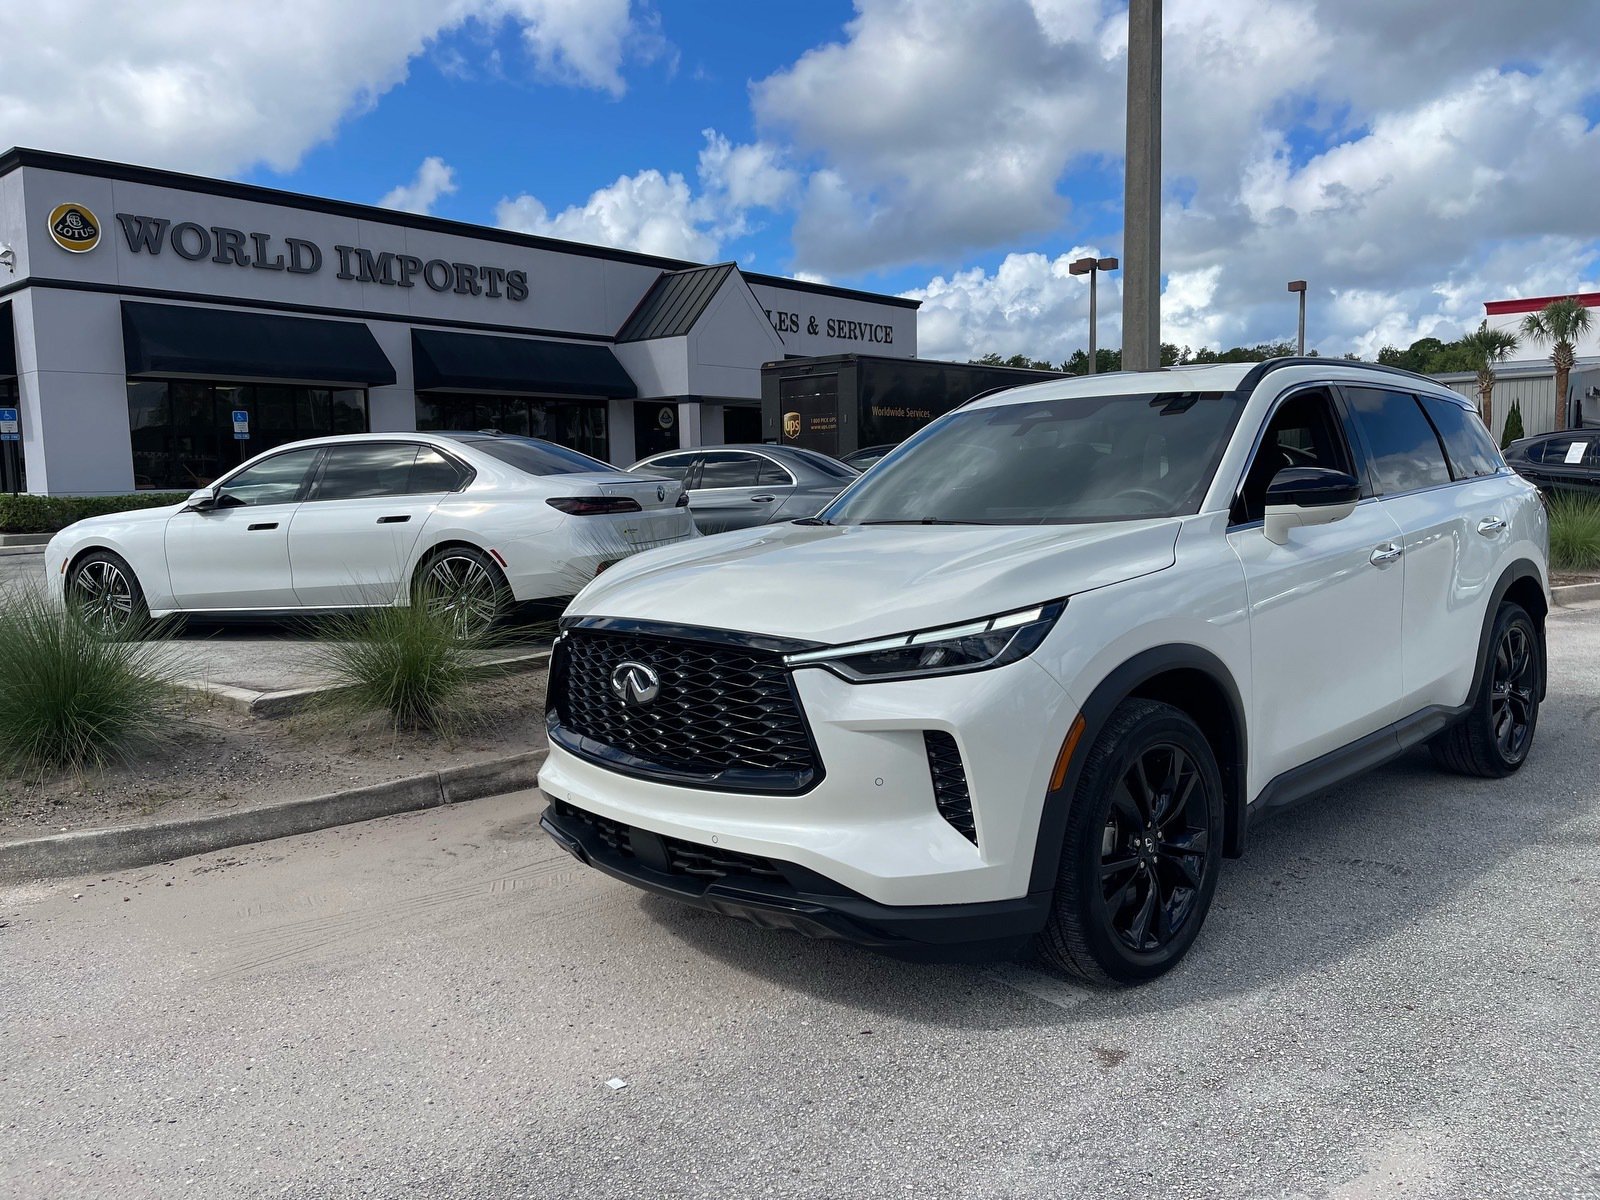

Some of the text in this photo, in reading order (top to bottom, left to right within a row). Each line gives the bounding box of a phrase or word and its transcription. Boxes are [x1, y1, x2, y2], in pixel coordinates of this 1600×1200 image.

[56, 224, 95, 238] LOTUS
[116, 213, 529, 301] WORLD IMPORTS
[807, 315, 819, 336] &
[826, 319, 893, 344] SERVICE
[871, 405, 930, 418] Worldwide Services
[785, 420, 800, 435] ups
